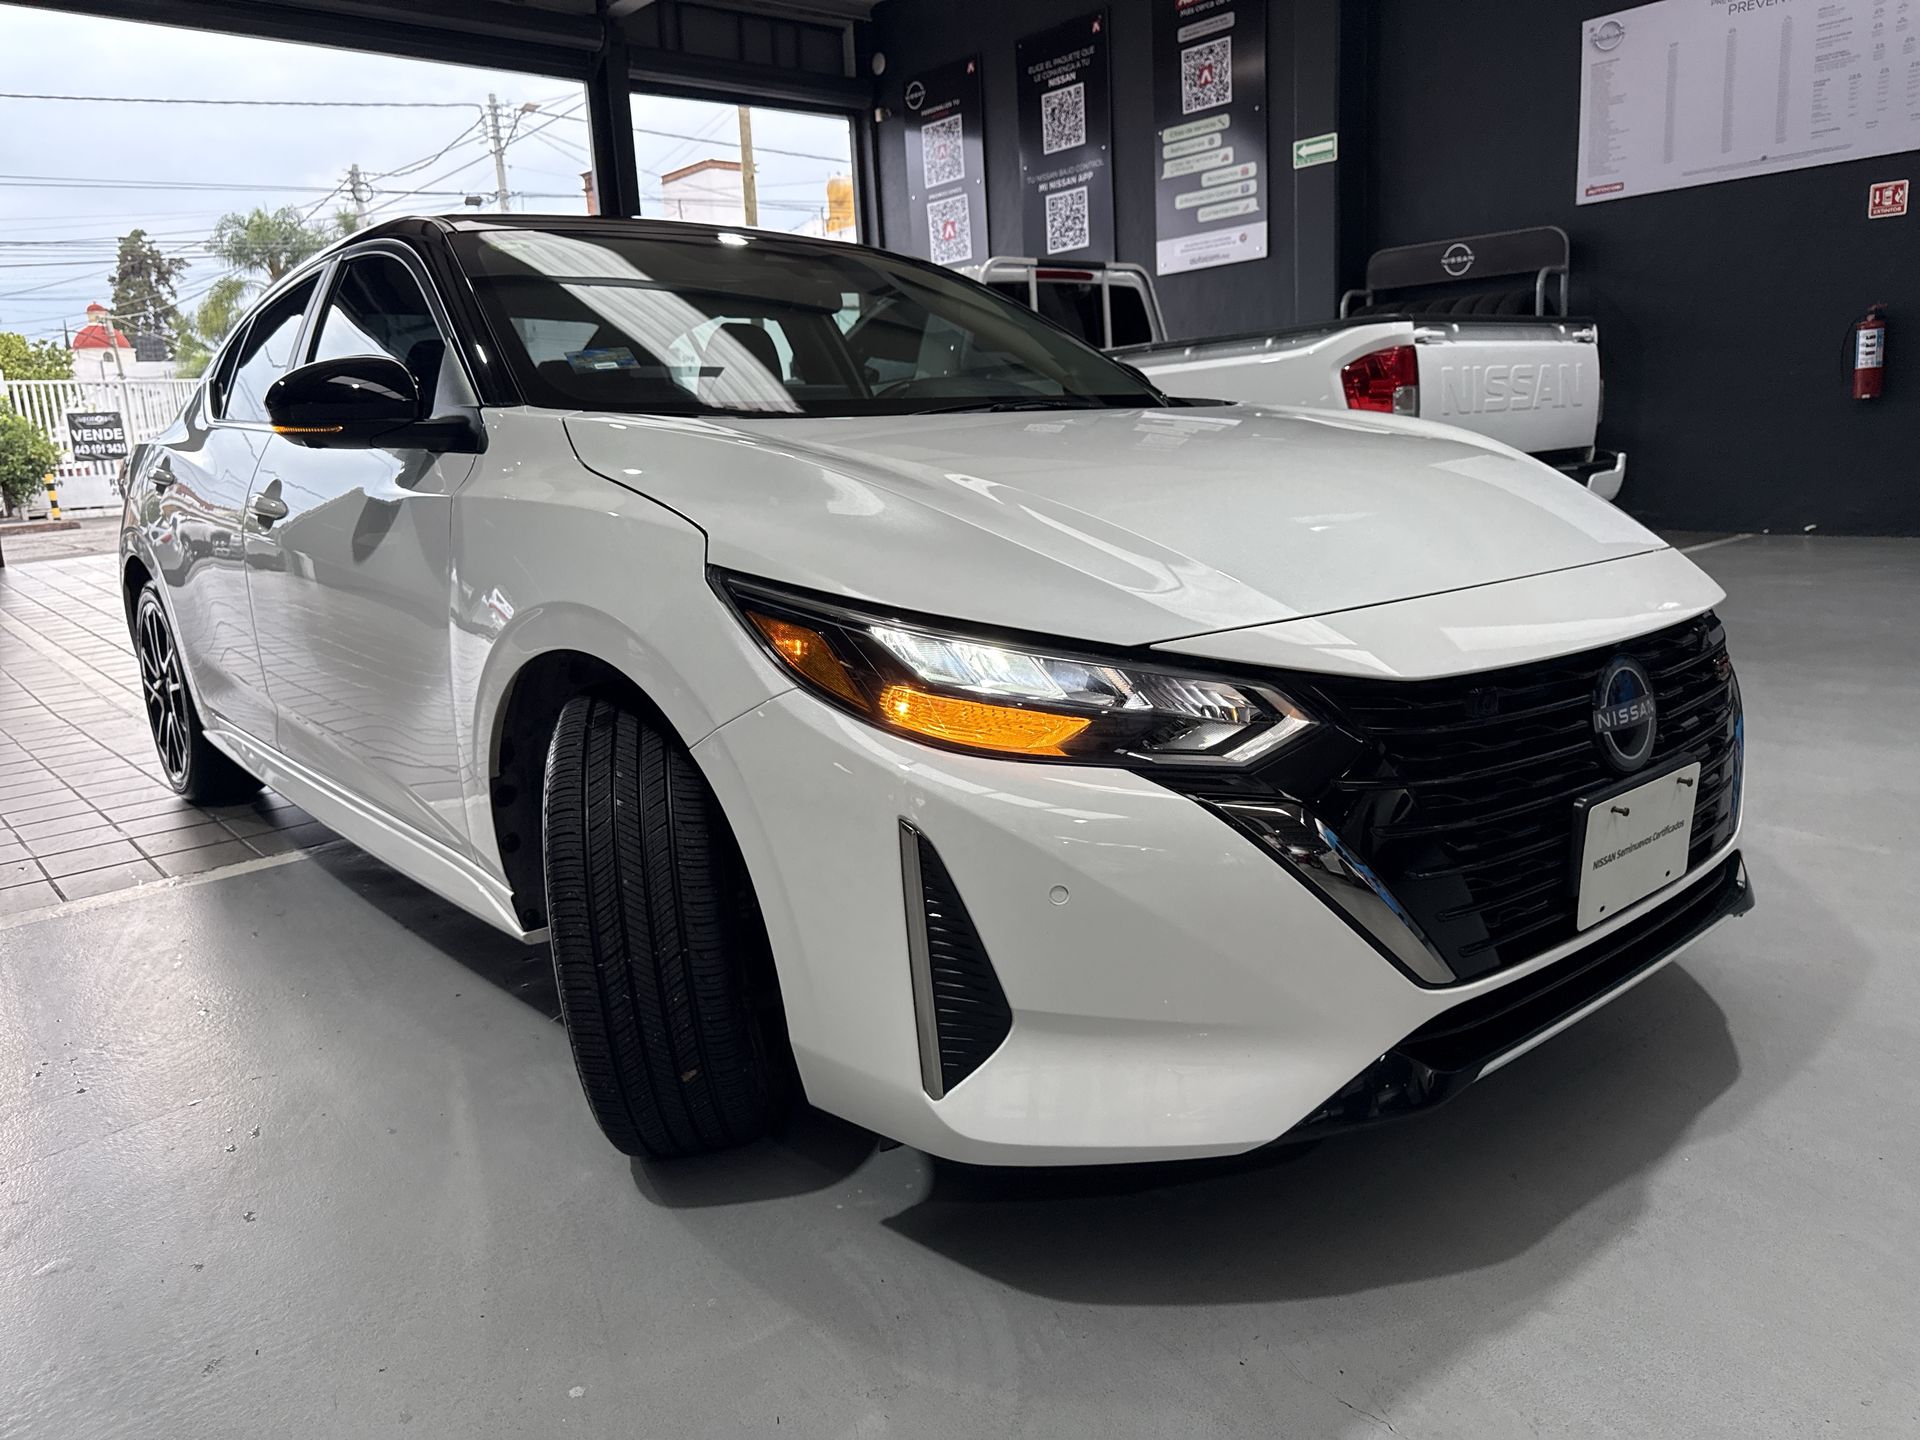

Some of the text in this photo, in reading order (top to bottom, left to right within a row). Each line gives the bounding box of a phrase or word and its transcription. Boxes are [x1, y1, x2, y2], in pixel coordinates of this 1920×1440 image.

[1047, 72, 1077, 88] NISSAN
[1075, 158, 1104, 173] CONTROL
[1038, 171, 1094, 193] MI NISSAN APP
[1872, 206, 1902, 214] EXTINTOR
[1441, 362, 1583, 416] NISSAN
[71, 428, 124, 442] VENDE
[1598, 698, 1654, 730] NISSAN
[1592, 819, 1685, 871] NISSAN Seminuevos Certificados
